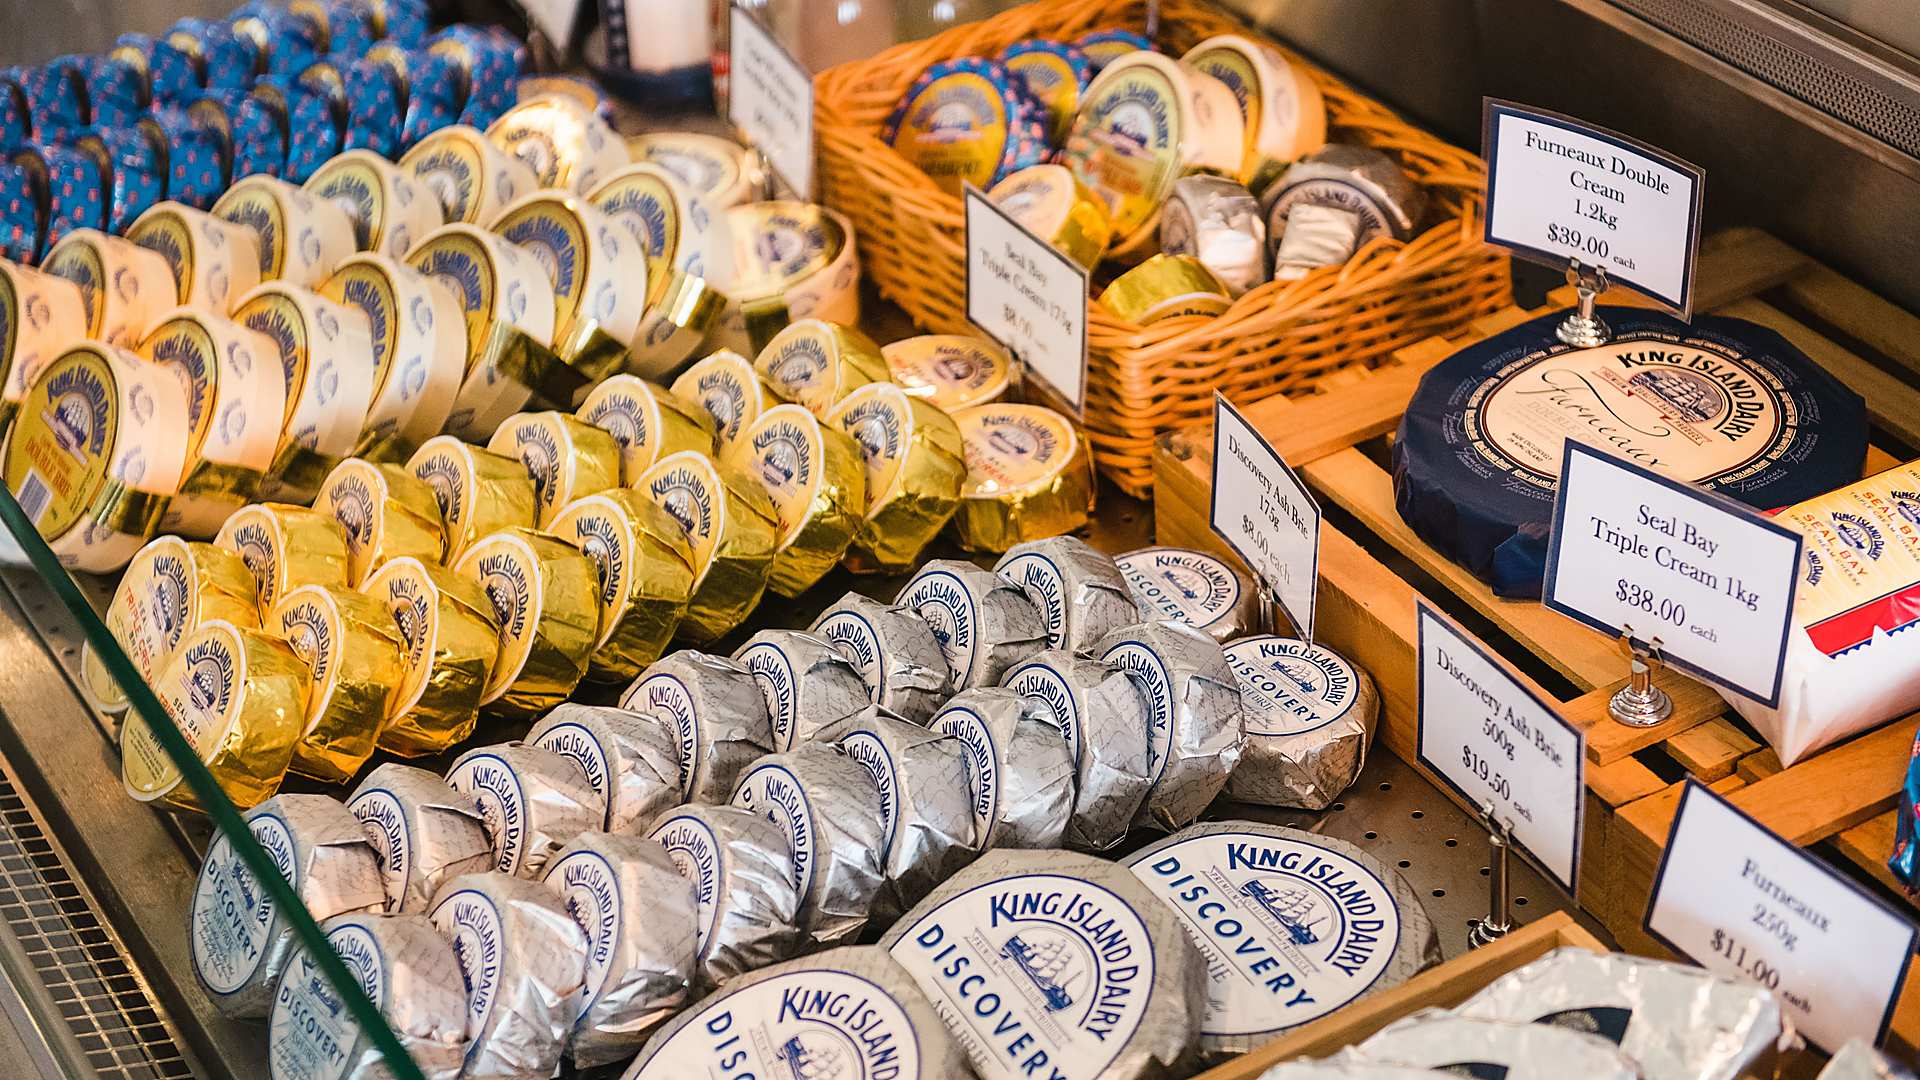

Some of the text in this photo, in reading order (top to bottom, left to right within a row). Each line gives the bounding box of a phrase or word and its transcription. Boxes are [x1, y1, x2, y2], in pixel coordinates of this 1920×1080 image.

[1525, 130, 1670, 195] Furneaux Double
[1570, 170, 1625, 204] Cream
[1547, 223, 1636, 271] $39.00 each
[1575, 199, 1618, 230] 1.2kg
[1616, 351, 1683, 368] KING
[1688, 355, 1756, 398] ISLAND
[752, 420, 810, 486] KING ISLAND DAIRY
[1720, 397, 1766, 442] DAIRY
[650, 467, 711, 539] KING ISLAND DAIRY
[1228, 434, 1309, 540] Discovery Ash Brie
[1258, 495, 1280, 533] 175g
[1862, 491, 1897, 521] SEAL
[1891, 490, 1915, 500] KING
[1242, 514, 1291, 585] $8.00 each
[1637, 504, 1719, 558] Seal Bay
[1803, 513, 1868, 576] SEAL BAY
[1831, 511, 1857, 522] KING
[1856, 516, 1881, 541] ISLAND
[576, 516, 623, 608] KING ISLAND DAIRY
[1117, 561, 1194, 626] DISCOVERY
[1155, 555, 1232, 613] KING ISLAND DAIRY
[1590, 516, 1760, 612] Triple Cream 1kg
[153, 555, 189, 651] KING ISLAND DAIRY
[479, 554, 529, 640] KING ISLAND DAIRY
[929, 580, 961, 609] ISLAND
[956, 602, 969, 649] DAIRY
[1024, 563, 1062, 630] KING ISLAND
[1615, 578, 1718, 644] $38.00 each
[282, 602, 330, 682] KING ISLAND DAIRY
[826, 622, 874, 666] SLAND DAIRY
[1259, 644, 1351, 707] KING ISLAND DAIRY
[185, 637, 234, 716] KING ISLAND DAIRY
[762, 652, 790, 737] ISLAND DAIRY
[1027, 675, 1072, 742] ISLAND DAIRY
[1127, 651, 1167, 731] ISLAND DAIRY
[1225, 652, 1321, 722] DISCOVERY
[1437, 647, 1563, 768] Discovery Ash Brie
[172, 697, 201, 738] SEAL BAY
[649, 685, 670, 710] KING
[670, 686, 691, 741] ISLAND
[965, 720, 988, 773] ISLAND
[1482, 717, 1515, 761] 500g
[472, 765, 499, 791] KING
[496, 771, 518, 828] ISLAND
[765, 776, 807, 850] KING ISLAND
[976, 768, 992, 821] DAIRY
[1462, 745, 1533, 823] $19.50 each
[267, 825, 290, 872] ISLAND
[207, 859, 257, 961] DISCOVERY
[563, 864, 615, 968] KING ISLAND DAIRY
[1227, 843, 1385, 977] KING ISLAND DAIRY
[1741, 858, 1832, 933] Furneaux
[1751, 904, 1799, 952] 250g
[453, 902, 497, 1019] KING ISLAND DAIRY
[1151, 856, 1315, 1009] DISCOVERY
[990, 892, 1138, 1042] KING ISLAND DAIRY
[1710, 928, 1811, 1014] $11.00 each
[279, 987, 344, 1067] DISCOVERY
[777, 985, 900, 1080] KING ISLAND
